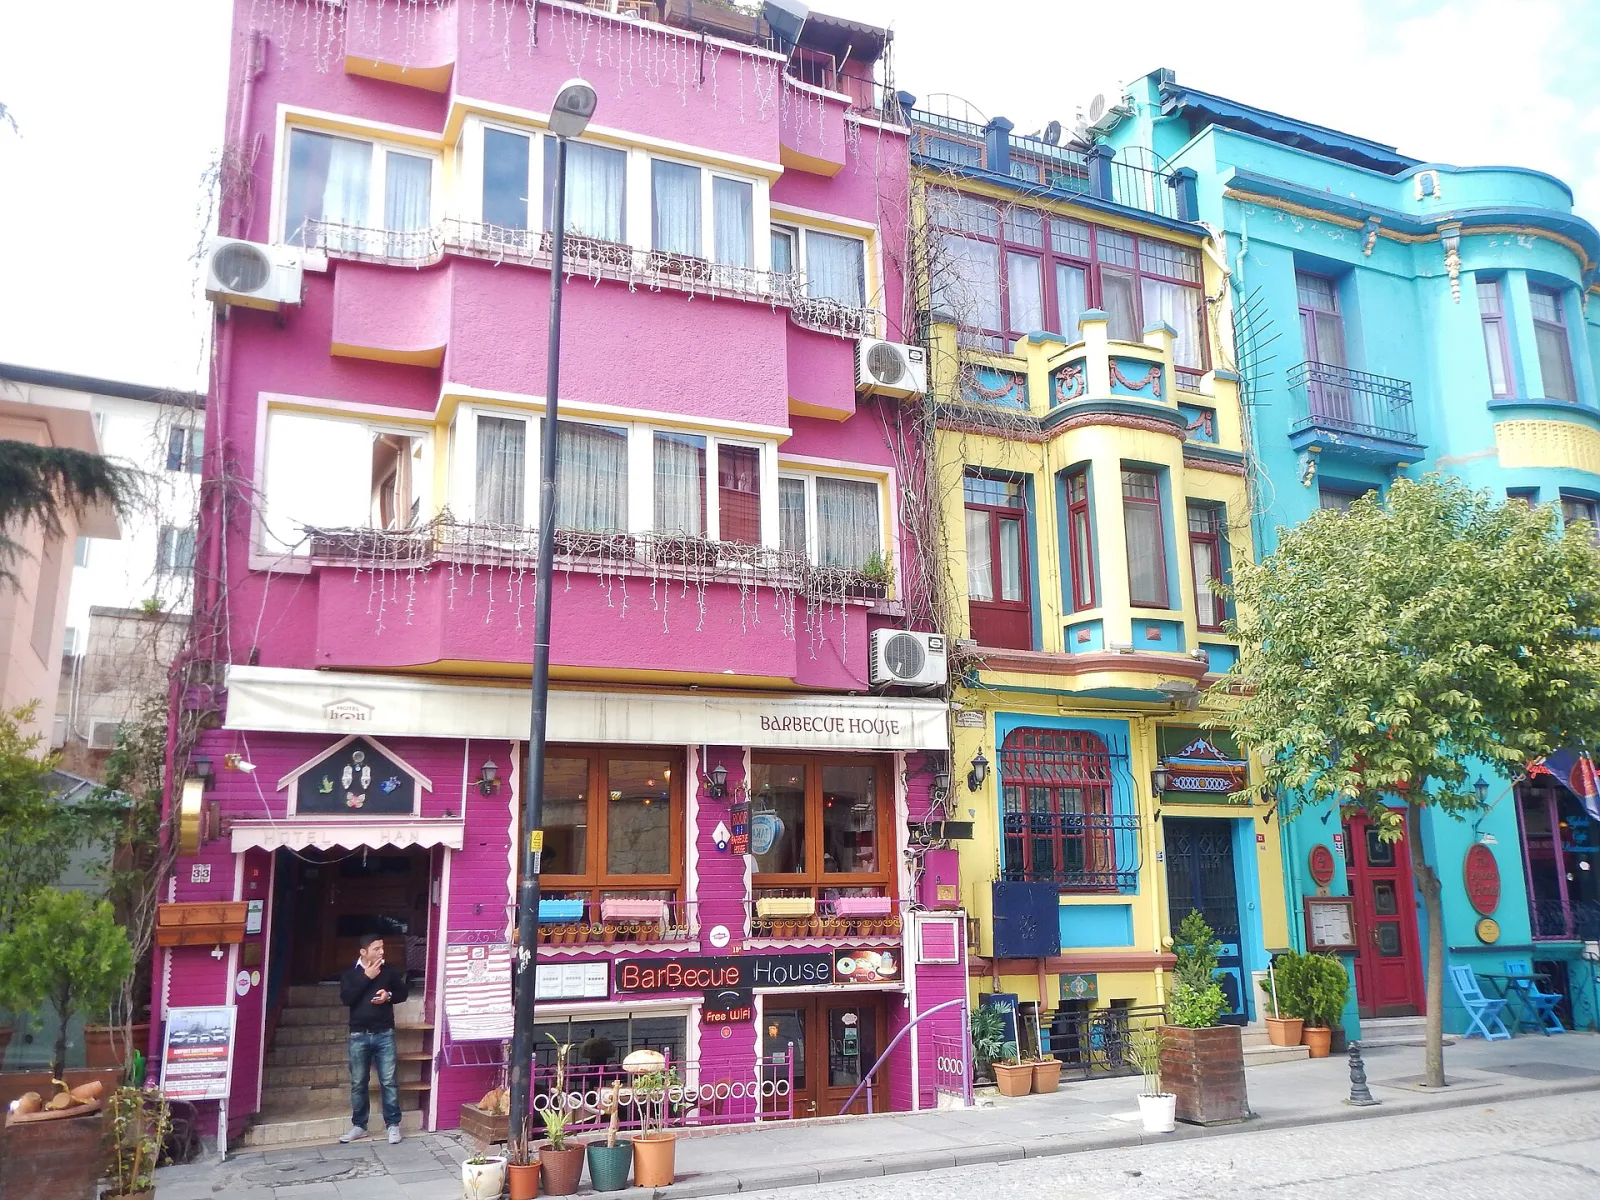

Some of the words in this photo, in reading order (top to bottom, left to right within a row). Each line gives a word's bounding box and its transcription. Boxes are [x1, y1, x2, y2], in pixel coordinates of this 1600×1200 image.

[759, 715, 845, 733] BARBECUE
[849, 717, 900, 737] HOUSE
[263, 830, 333, 845] HOTEL
[380, 828, 420, 843] HAN
[623, 963, 740, 989] BarBecue
[754, 959, 830, 985] House
